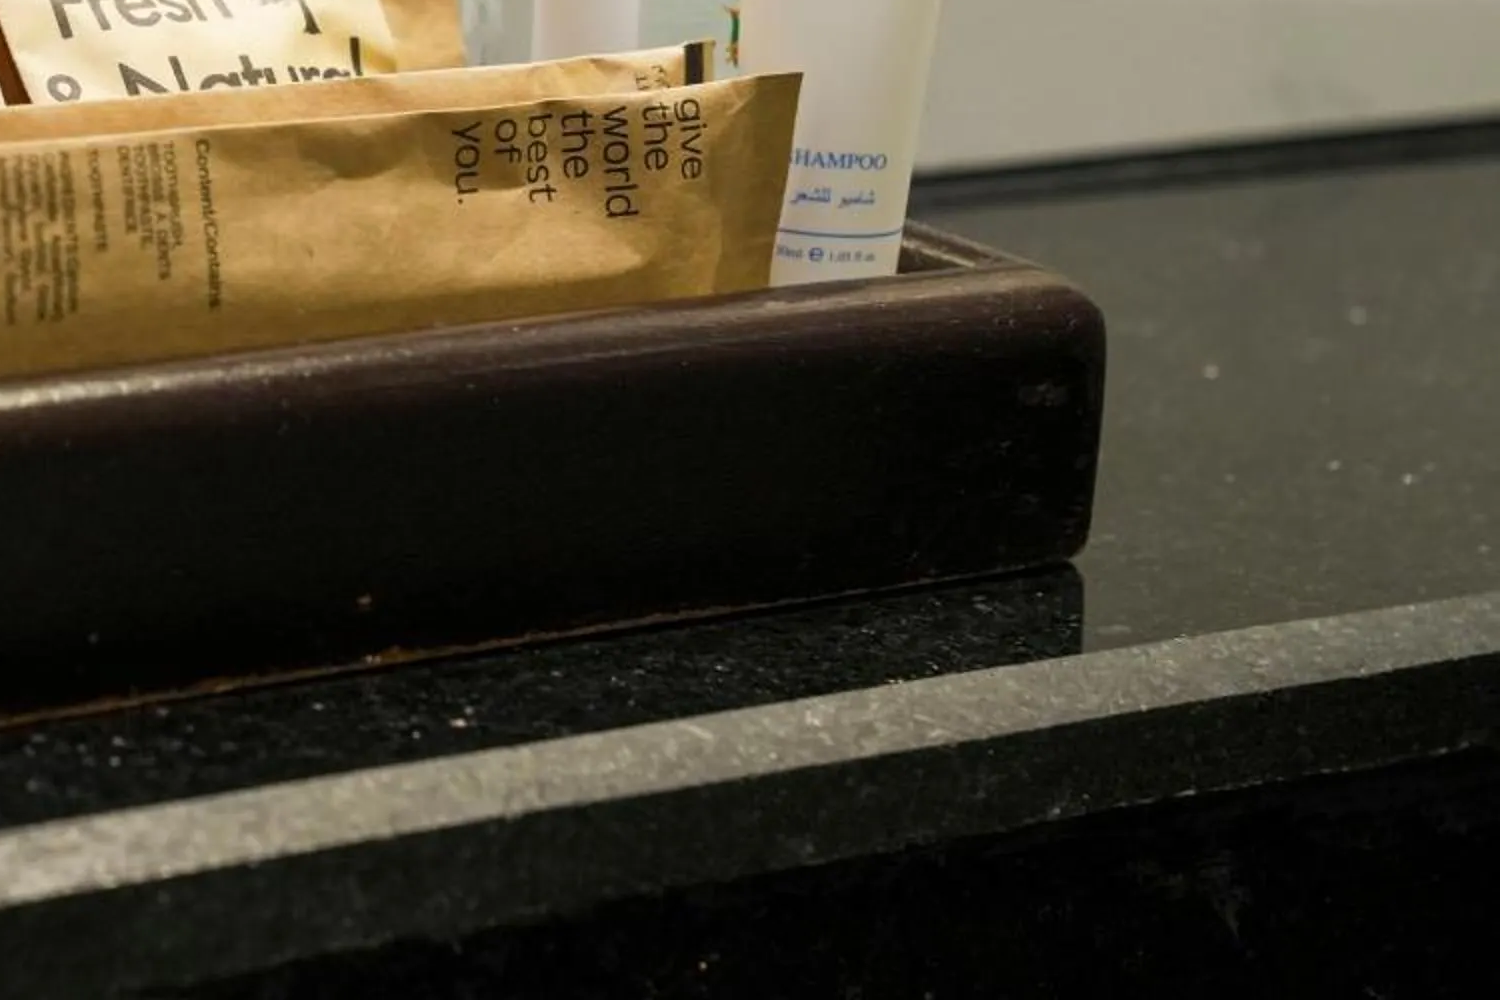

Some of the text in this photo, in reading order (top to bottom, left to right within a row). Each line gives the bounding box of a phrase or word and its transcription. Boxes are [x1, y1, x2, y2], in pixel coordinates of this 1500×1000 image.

[451, 120, 483, 205] you.
[493, 118, 523, 165] of
[526, 113, 557, 204] best
[560, 109, 596, 180] the
[602, 105, 639, 218] world
[641, 101, 675, 171] the
[673, 98, 708, 180] give
[790, 147, 888, 171] HAMPOO
